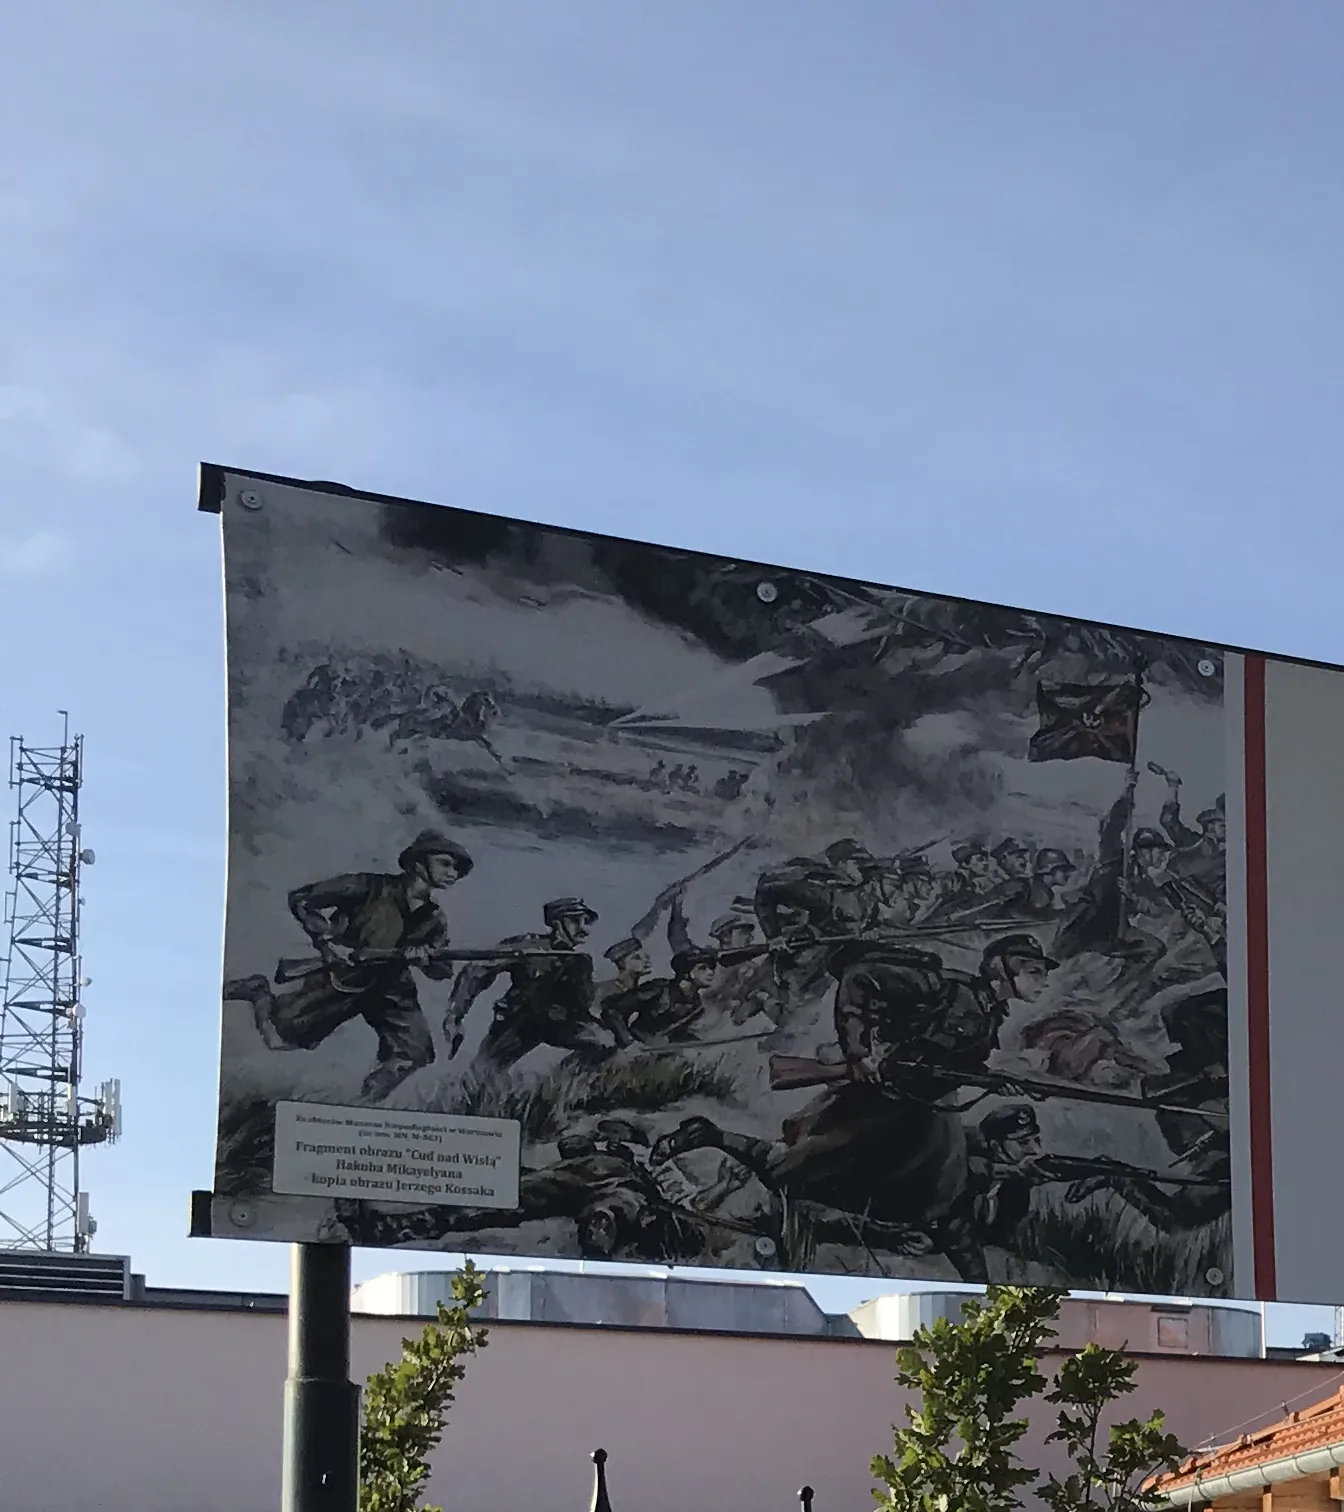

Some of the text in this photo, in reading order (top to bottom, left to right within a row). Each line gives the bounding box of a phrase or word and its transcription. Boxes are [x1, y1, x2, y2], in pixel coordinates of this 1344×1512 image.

[296, 1141, 356, 1156] Fragment
[359, 1146, 402, 1159] obrazu
[437, 1151, 460, 1164] nad
[387, 1162, 463, 1181] Mikayelyana
[312, 1172, 495, 1197] kopia obrazu Jerzego Kossaka
